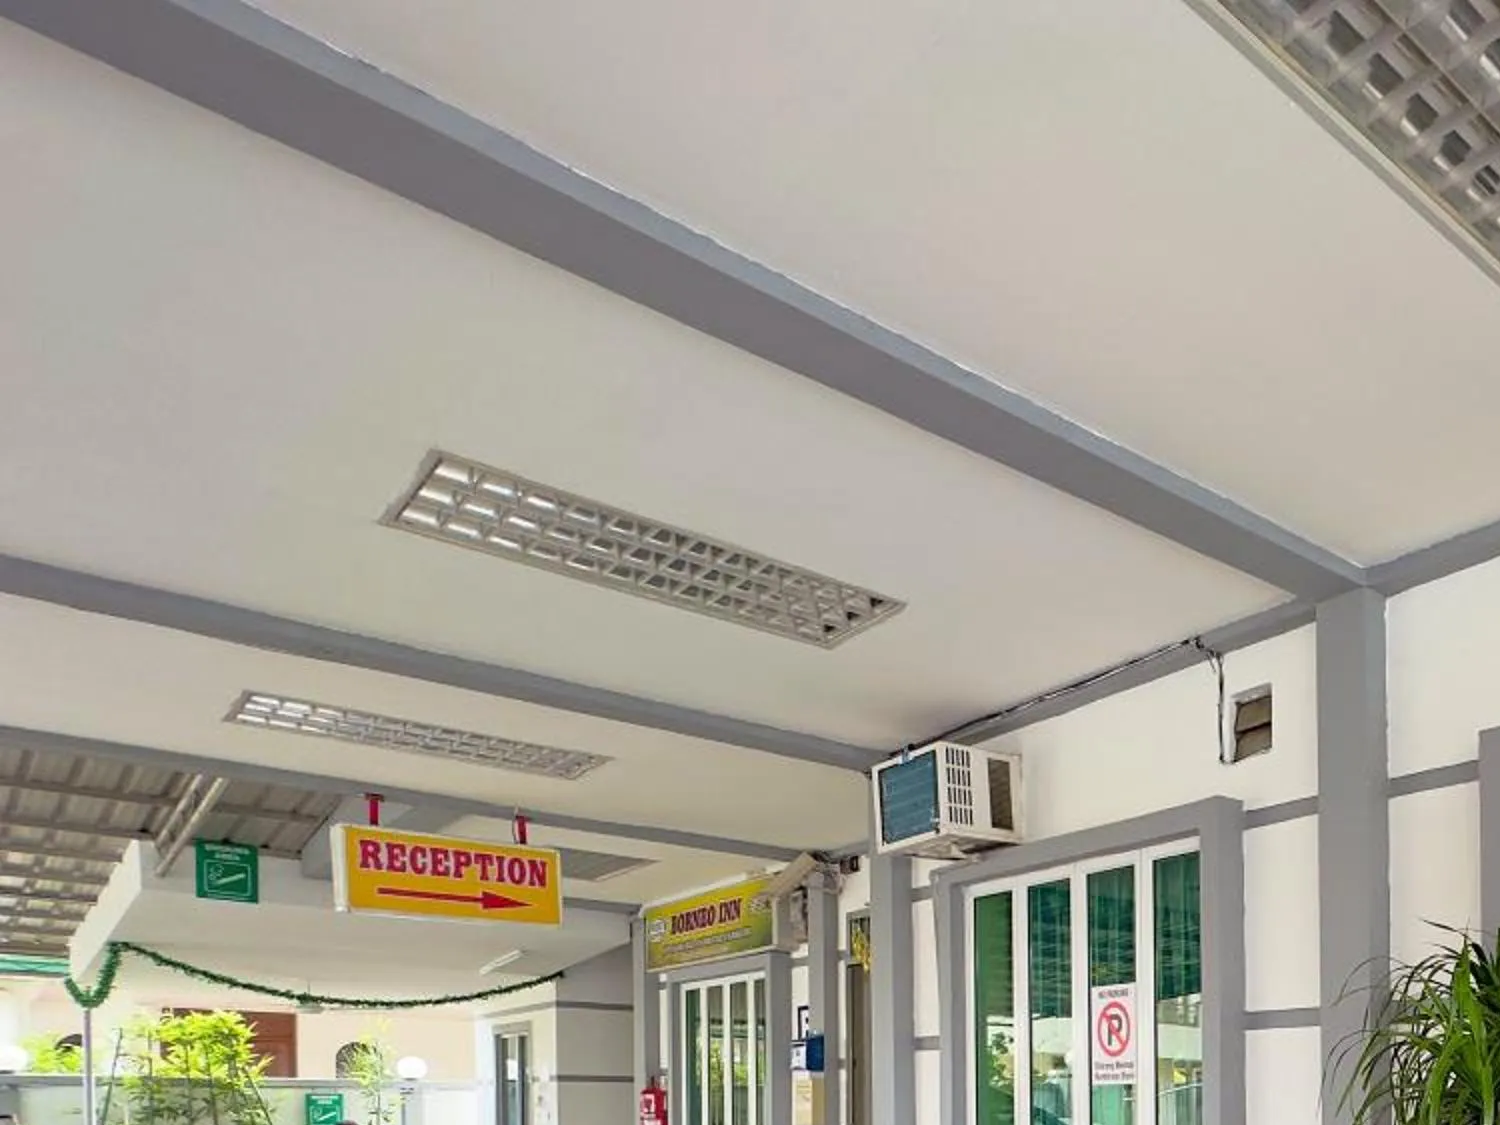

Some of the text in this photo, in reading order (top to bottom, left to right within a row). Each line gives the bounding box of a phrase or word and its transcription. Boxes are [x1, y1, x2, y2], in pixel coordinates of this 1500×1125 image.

[359, 839, 547, 887] RECEPTION
[671, 905, 716, 935] BORNEO
[719, 897, 742, 923] INN
